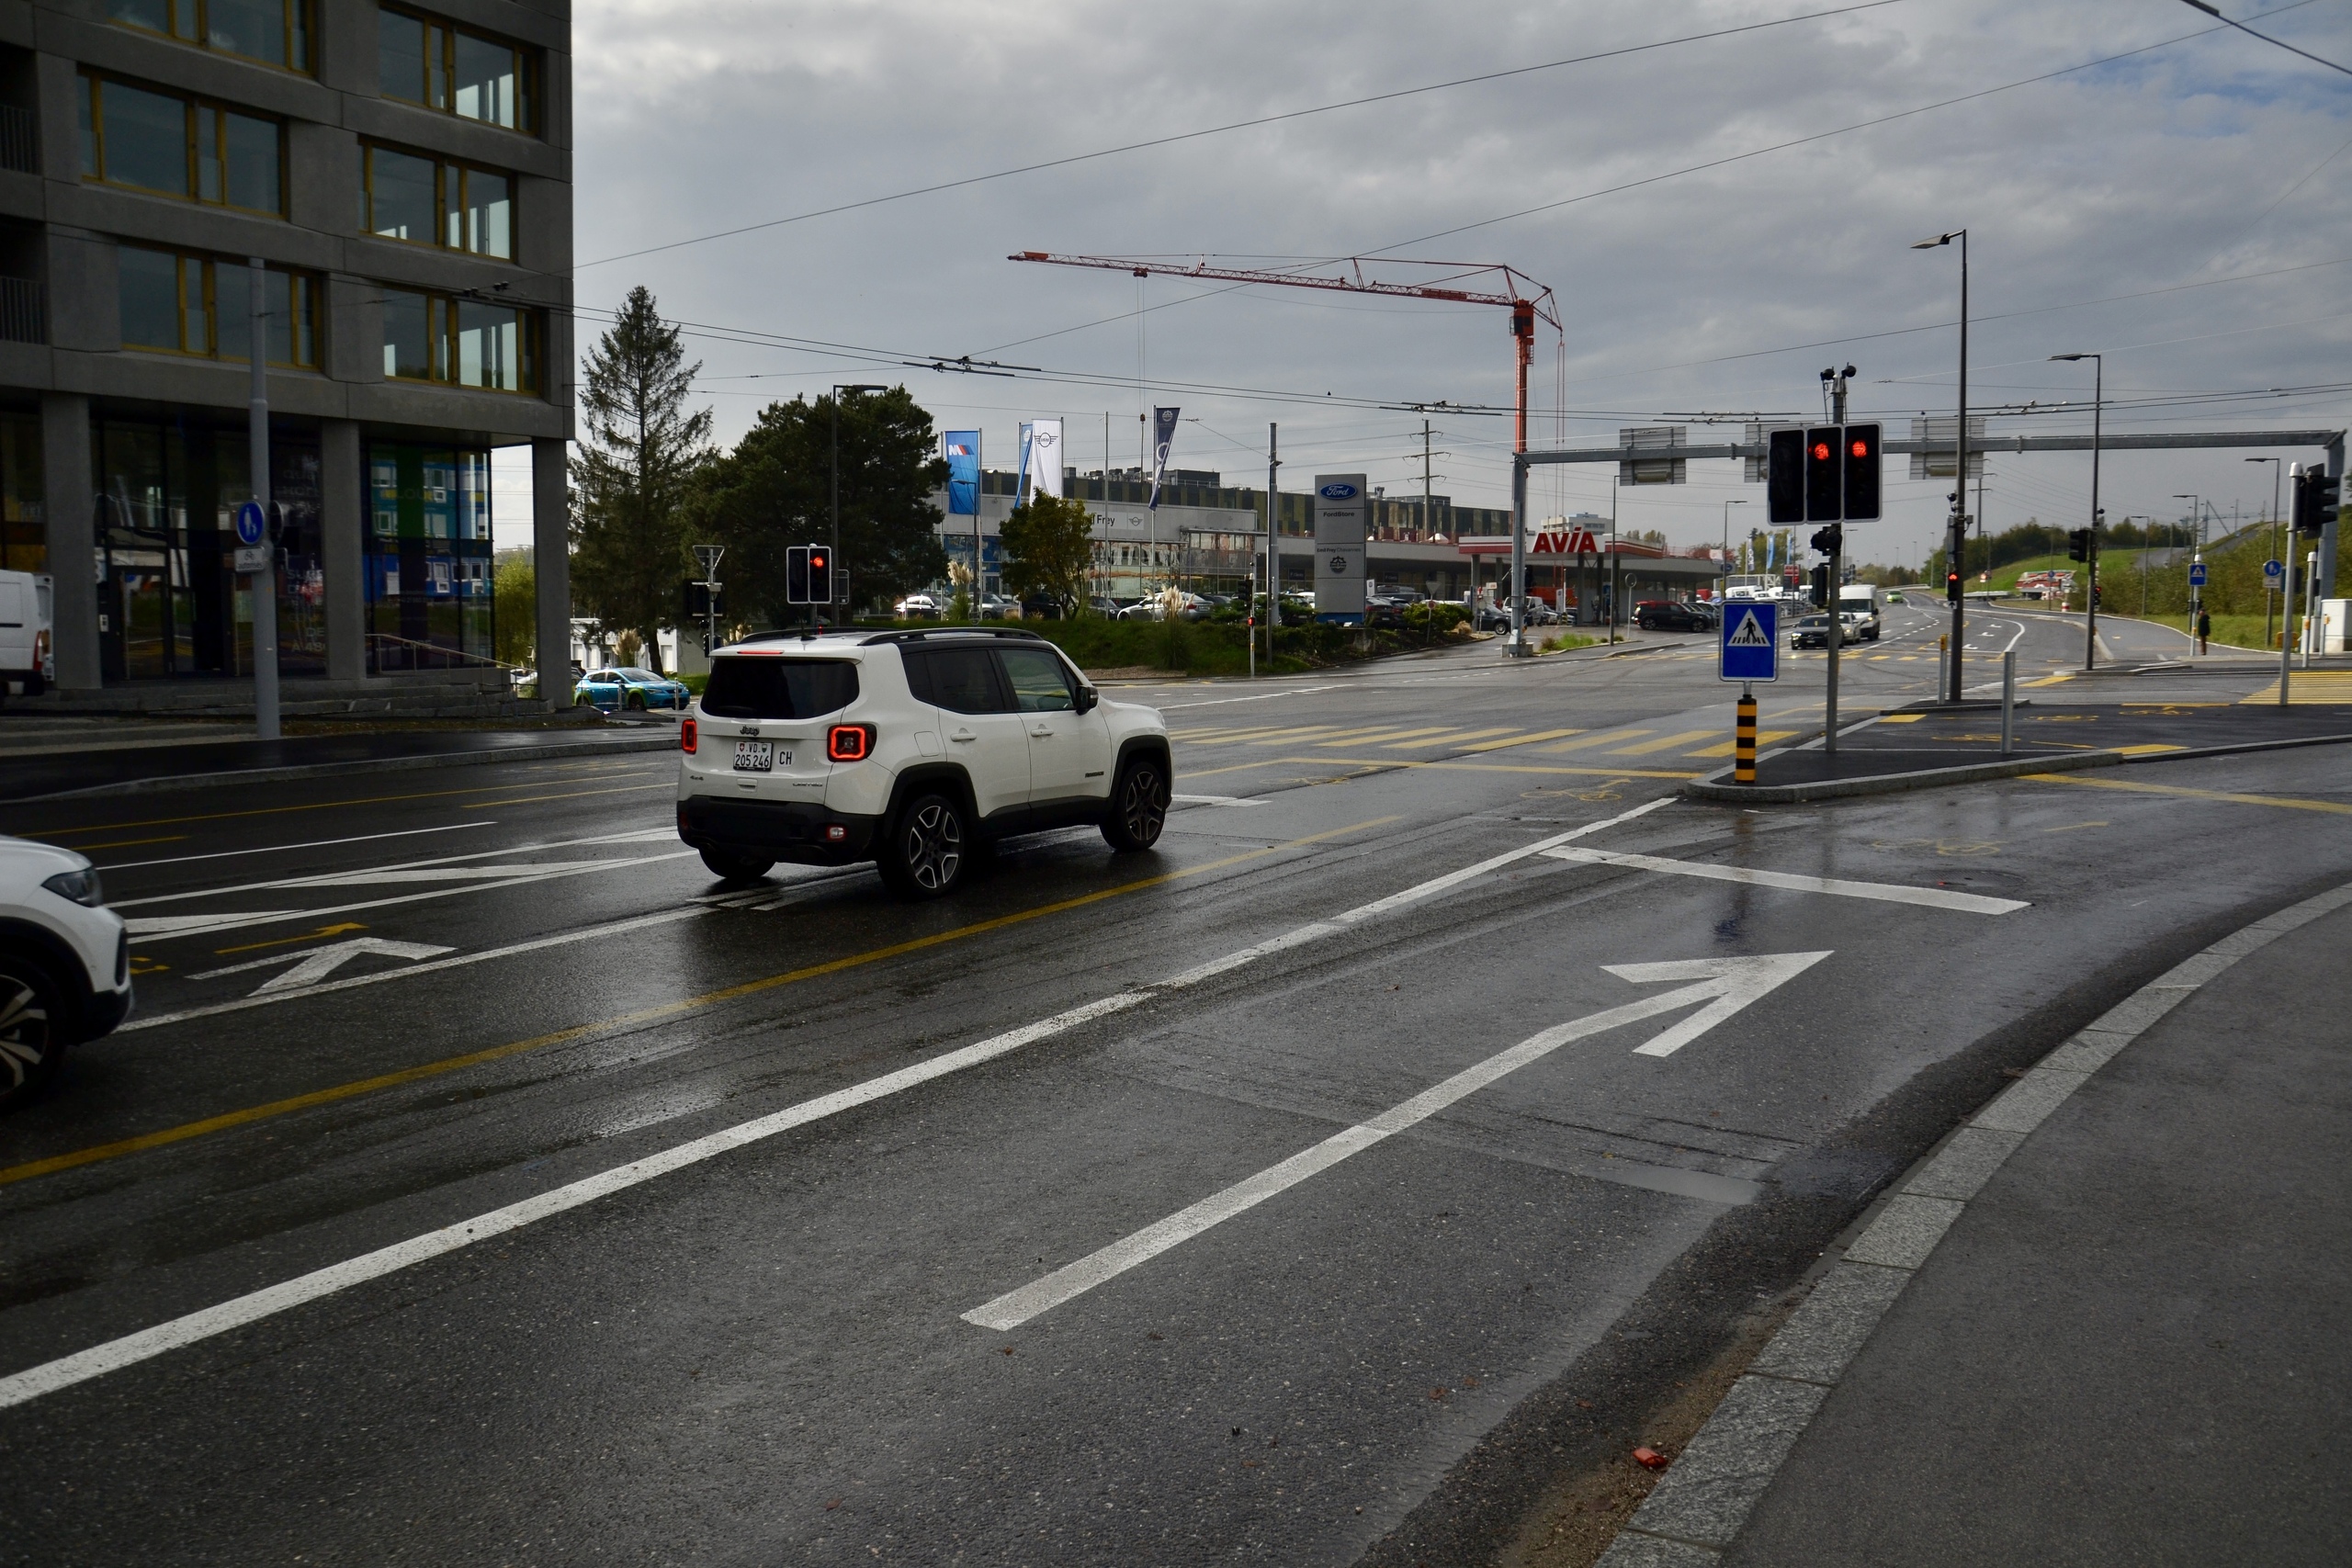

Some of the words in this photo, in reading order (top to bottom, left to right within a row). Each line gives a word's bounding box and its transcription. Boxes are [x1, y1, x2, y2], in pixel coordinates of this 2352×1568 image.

[1326, 485, 1349, 496] Ford
[1532, 526, 1598, 553] AVIA
[740, 725, 760, 736] Jeep
[735, 753, 752, 767] 205
[752, 754, 769, 768] 246
[779, 751, 792, 765] CH
